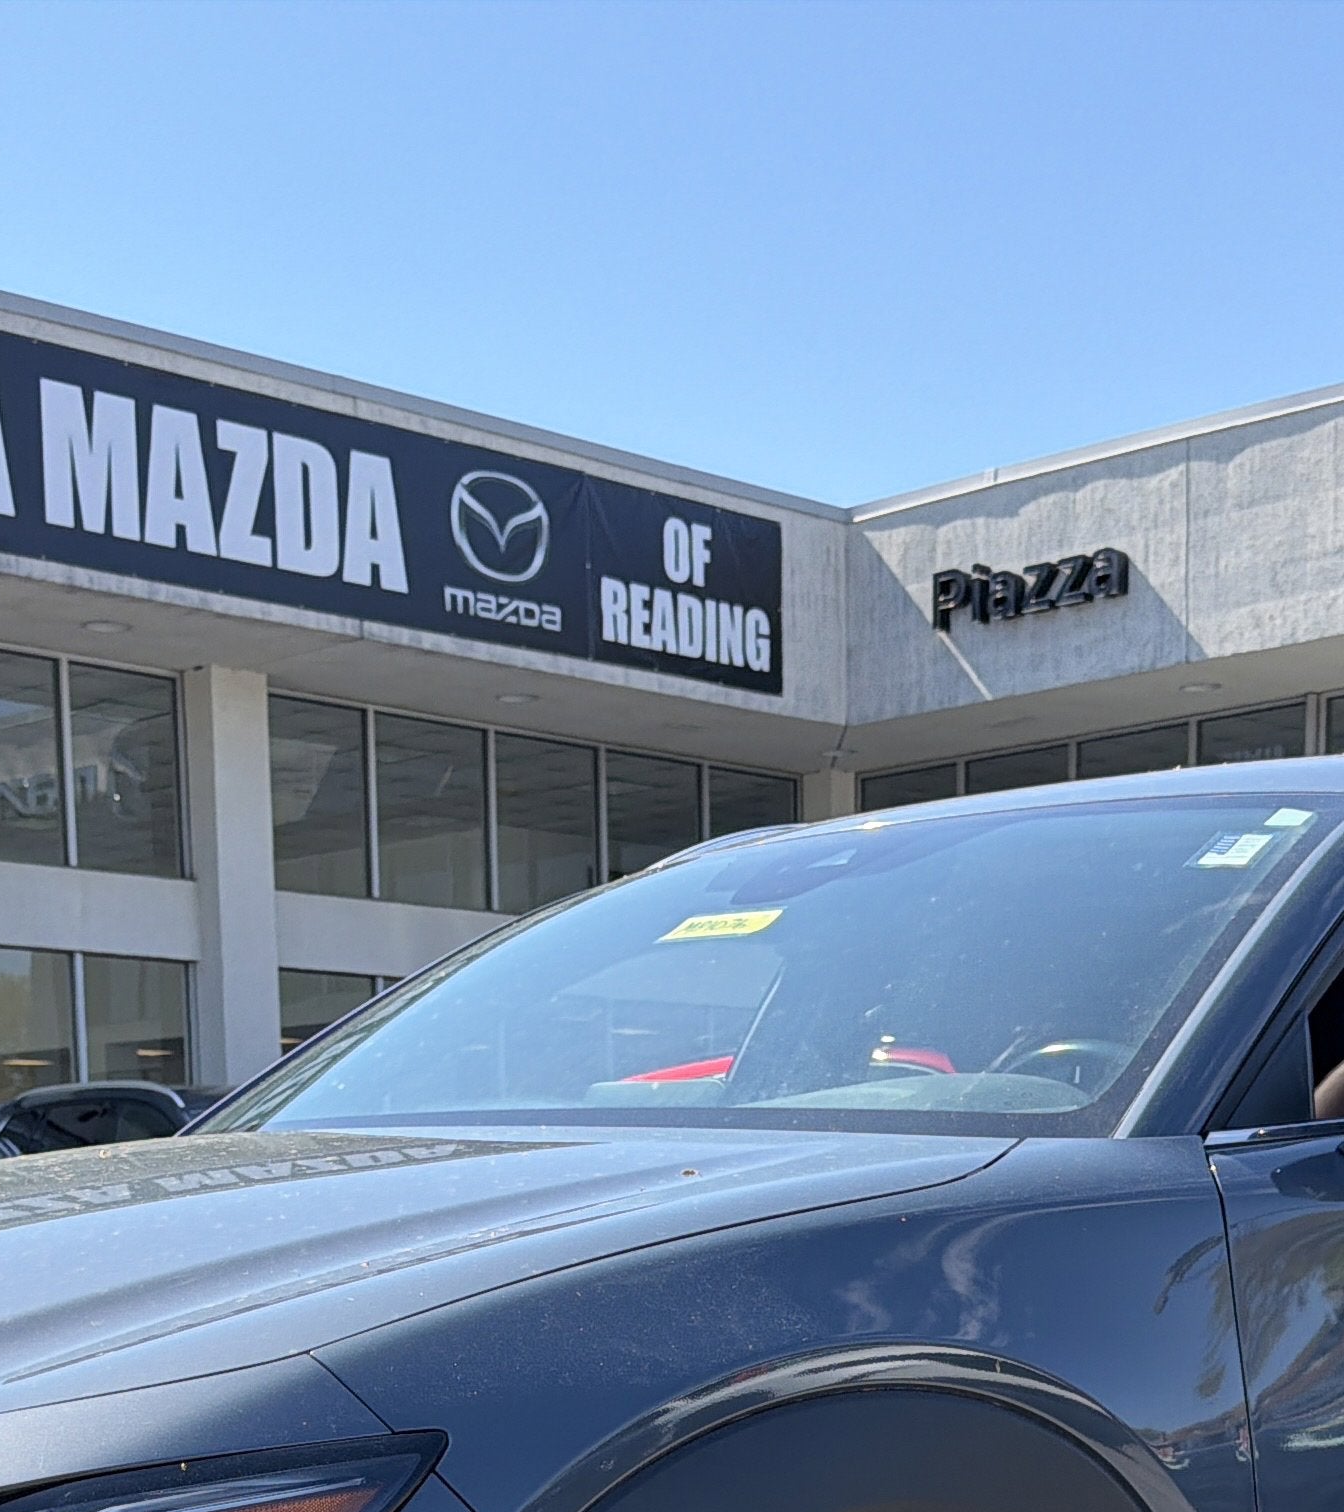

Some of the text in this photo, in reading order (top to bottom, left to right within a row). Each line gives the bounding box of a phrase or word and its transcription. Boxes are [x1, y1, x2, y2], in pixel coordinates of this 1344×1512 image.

[39, 376, 410, 595] MAZDA
[663, 516, 713, 588] OF
[932, 547, 1130, 634] Piazza
[443, 585, 563, 633] mazda
[600, 576, 772, 673] READING
